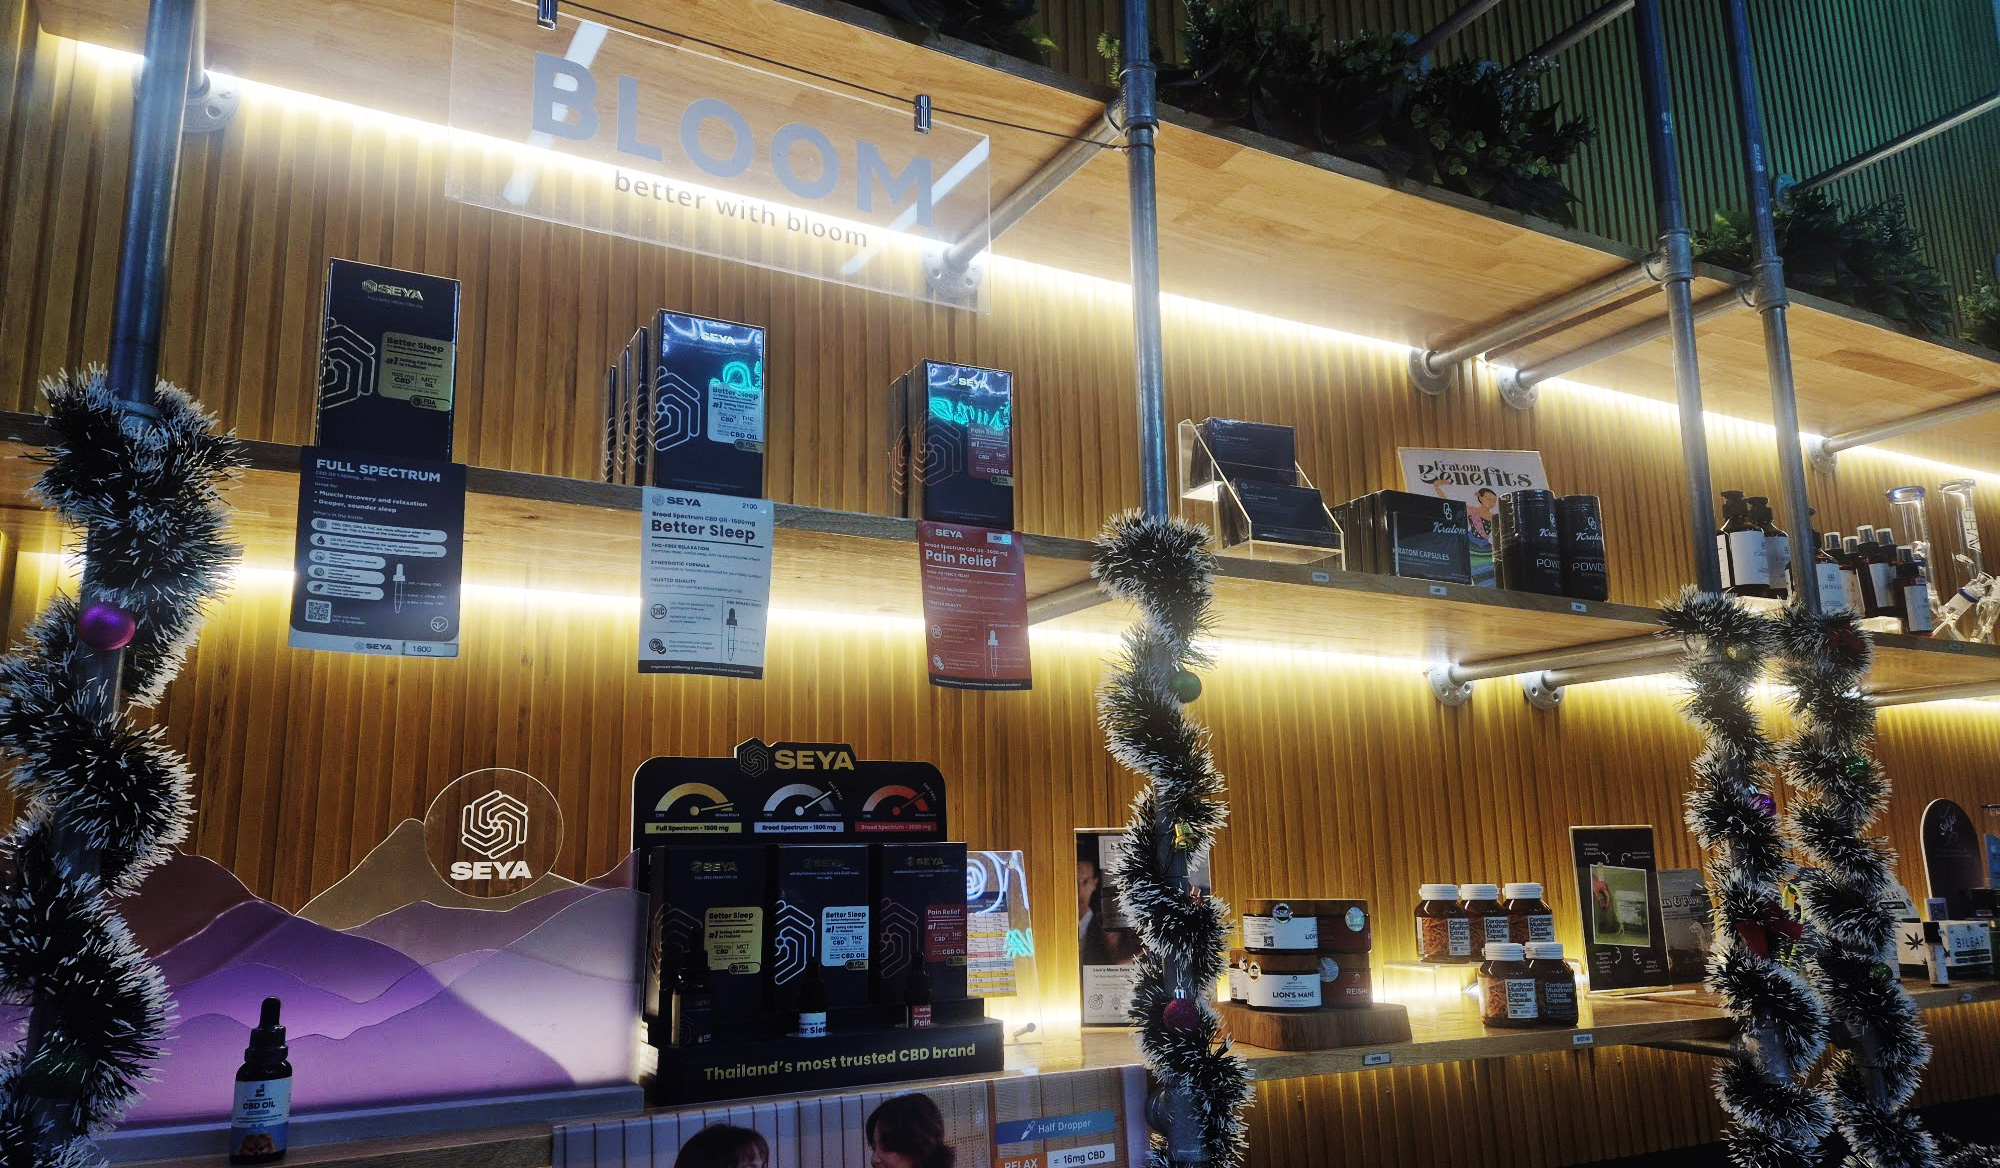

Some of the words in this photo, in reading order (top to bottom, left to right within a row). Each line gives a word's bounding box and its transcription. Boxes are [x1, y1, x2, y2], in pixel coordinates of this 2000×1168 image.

[532, 51, 933, 227] BLOOM
[614, 169, 706, 209] better
[715, 195, 776, 227] with
[786, 204, 868, 248] bloom
[377, 284, 424, 301] SEYA
[700, 331, 736, 346] SEYA
[387, 337, 416, 348] Better
[418, 342, 444, 354] Sleep
[421, 376, 438, 384] MCT
[958, 377, 990, 390] SEYA
[712, 386, 736, 396] Better
[712, 401, 723, 409] #1
[730, 431, 745, 439] CBD
[746, 433, 758, 441] OIL
[970, 427, 985, 435] Pain
[316, 458, 356, 473] FULL
[359, 464, 441, 483] SPECTRUM
[1434, 460, 1481, 472] Kratom
[1418, 464, 1532, 487] Benefits
[319, 489, 344, 499] Muscle
[345, 494, 377, 503] recovery
[377, 497, 392, 505] and
[392, 498, 428, 508] relaxation
[666, 496, 702, 508] SEYA
[318, 498, 346, 509] Deeper,
[347, 503, 377, 511] sounder
[378, 505, 397, 514] sleep
[742, 502, 758, 510] 2100
[672, 513, 704, 521] Spectrum
[651, 519, 706, 535] Better
[709, 524, 756, 543] Sleep
[935, 528, 963, 539] SEYA
[1433, 521, 1467, 535] Kratom
[677, 544, 710, 552] RELAXATION
[940, 543, 966, 552] Spectrum
[925, 549, 956, 564] Pain
[959, 553, 997, 568] Relief
[1392, 547, 1419, 558] KRATOM
[1419, 550, 1450, 561] CAPSULES
[365, 642, 393, 651] SEYA
[412, 645, 432, 654] 1800
[775, 750, 855, 771] SEYA
[668, 825, 699, 833] Spectrum
[703, 861, 738, 872] SEYA
[916, 857, 945, 866] SEYA
[450, 860, 533, 881] SEYA
[708, 912, 733, 920] Better
[733, 911, 754, 920] Sleep
[825, 911, 847, 919] Better
[847, 911, 867, 919] Sleep
[942, 908, 960, 916] Relief
[825, 926, 835, 934] #1
[927, 922, 936, 931] #1
[708, 931, 719, 939] #1
[1956, 935, 1985, 949] BILEAF
[1272, 991, 1297, 999] LION'S
[1297, 990, 1315, 998] MANE
[914, 1017, 931, 1026] Pain
[704, 1057, 793, 1082] Thailand's
[796, 1056, 837, 1073] most
[840, 1050, 896, 1069] trusted
[898, 1047, 930, 1062] CBD
[932, 1043, 976, 1059] brand
[243, 1102, 260, 1110] CBD
[262, 1100, 276, 1108] OIL
[1038, 1121, 1056, 1134] Half
[1057, 1119, 1092, 1134] Dropper
[1063, 1153, 1086, 1165] 16mg
[1087, 1150, 1106, 1162] CBD
